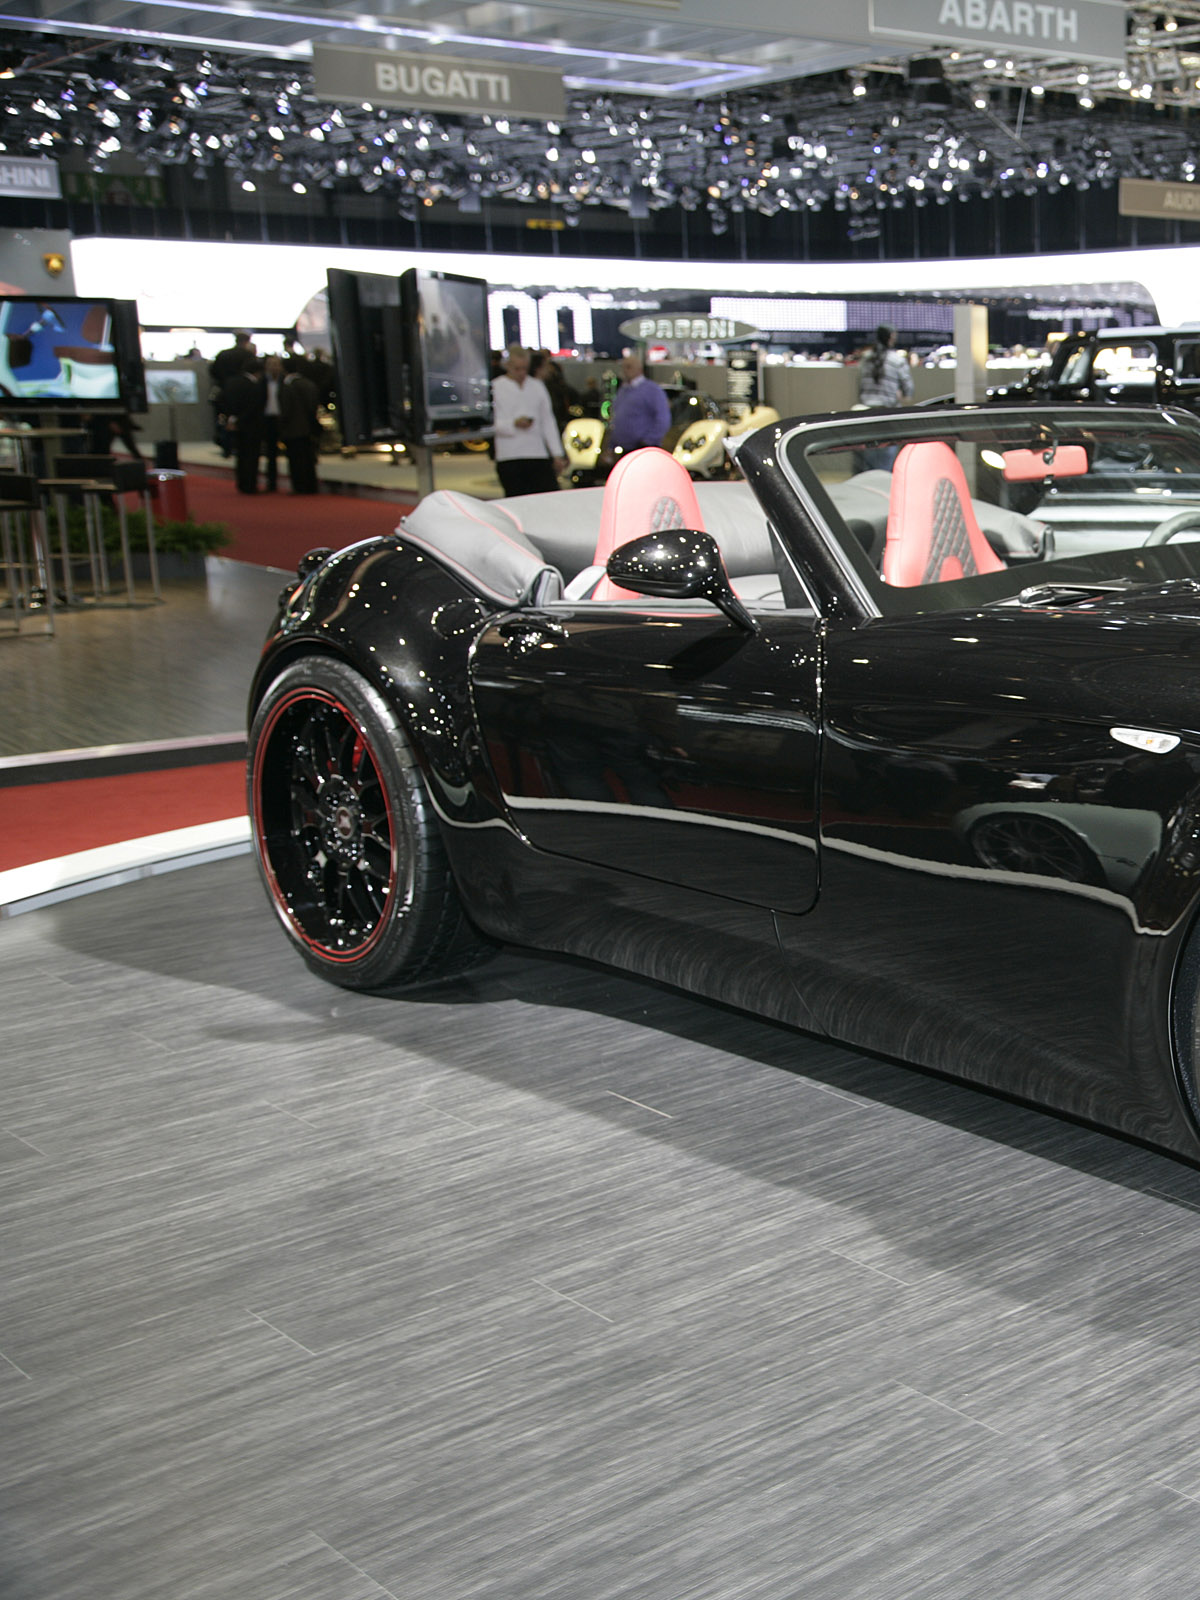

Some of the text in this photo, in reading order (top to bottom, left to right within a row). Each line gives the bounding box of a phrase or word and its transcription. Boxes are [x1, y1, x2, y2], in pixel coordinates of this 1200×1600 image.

[938, 0, 1078, 42] ABARTH
[375, 62, 511, 102] BUGATTI
[0, 165, 51, 189] HINI
[639, 318, 736, 339] PAGANI
